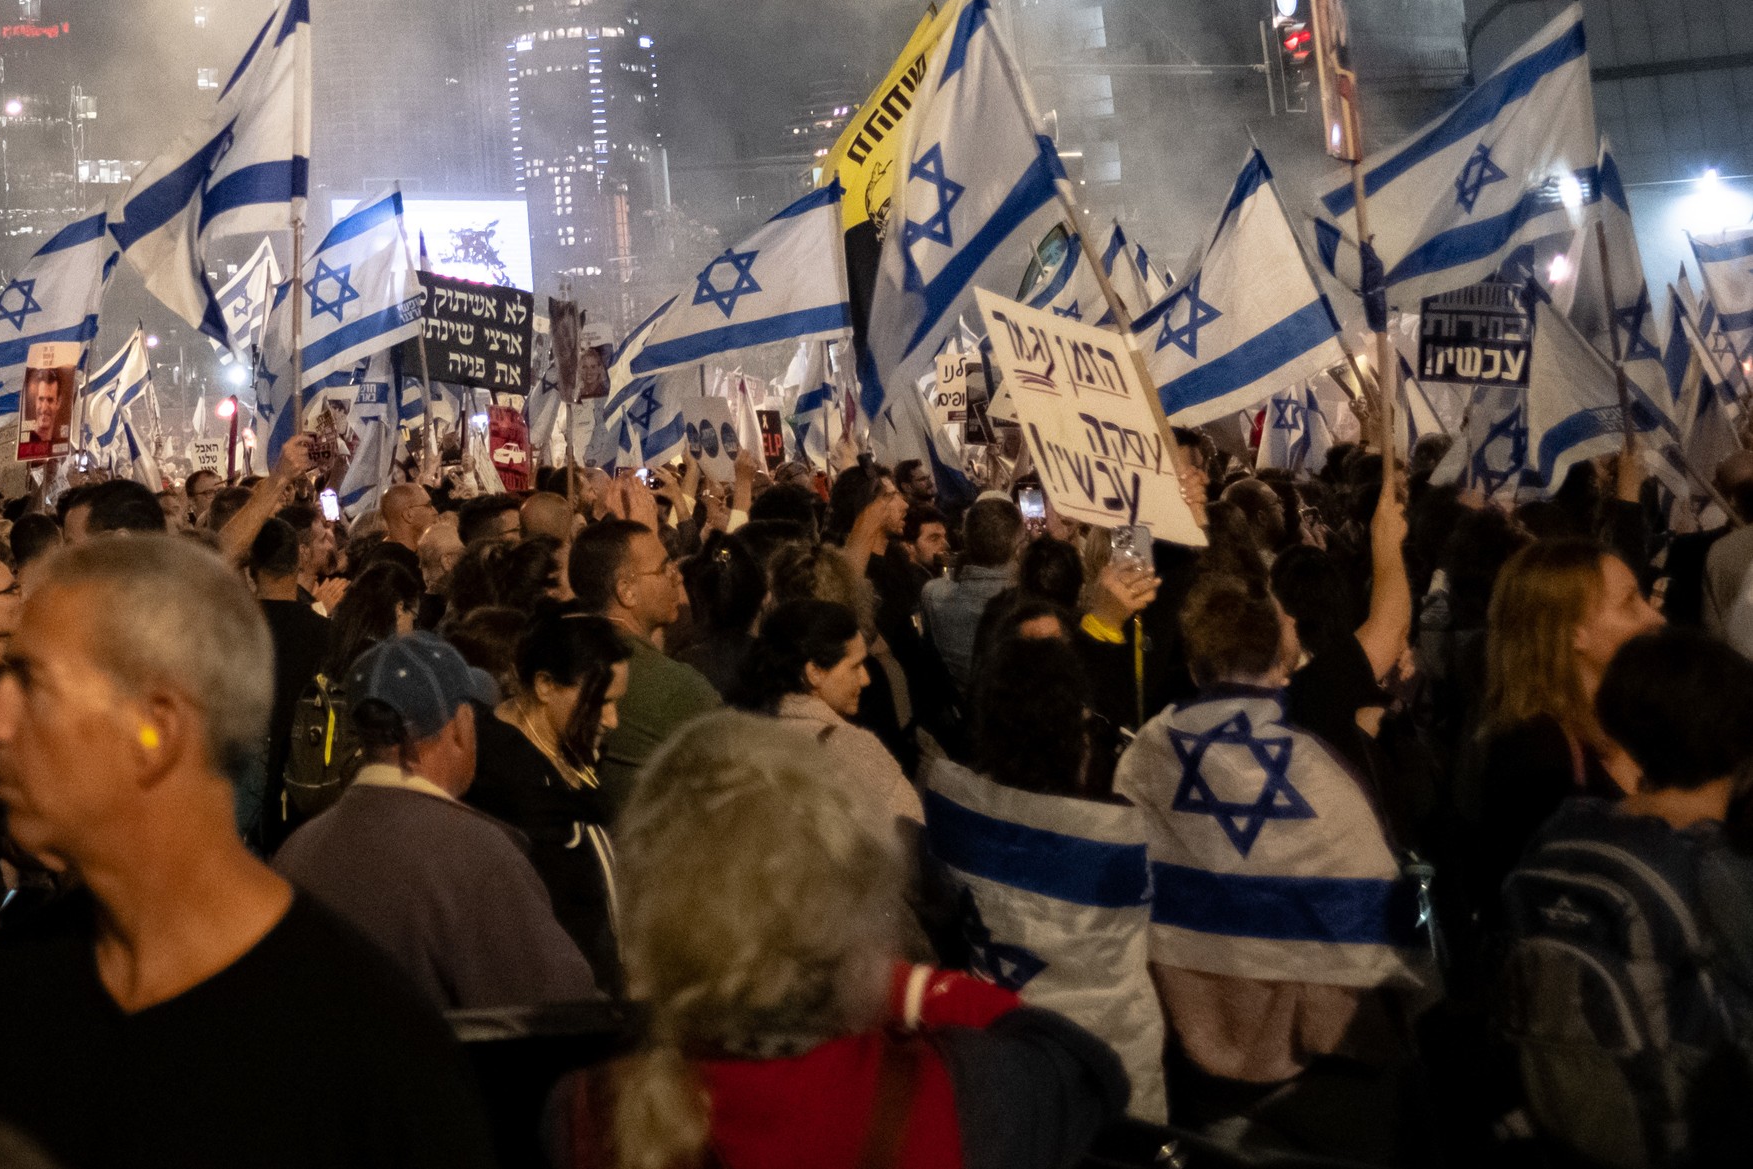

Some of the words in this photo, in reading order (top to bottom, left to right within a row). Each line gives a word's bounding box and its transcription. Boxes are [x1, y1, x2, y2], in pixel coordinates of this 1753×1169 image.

[434, 287, 497, 319] אשתוק
[504, 293, 527, 325] לא
[484, 327, 523, 356] ארצי
[992, 310, 1056, 380] נגמר
[449, 352, 486, 379] פניה
[494, 361, 521, 386] את
[943, 357, 967, 383] לנו
[1056, 335, 1130, 399] הזמן
[1425, 344, 1526, 381] עכשיו!
[937, 392, 965, 407] ופים
[194, 442, 219, 453] האבל
[762, 433, 782, 456] ELP
[1078, 412, 1162, 475] עסקה
[198, 453, 218, 464] שלנו
